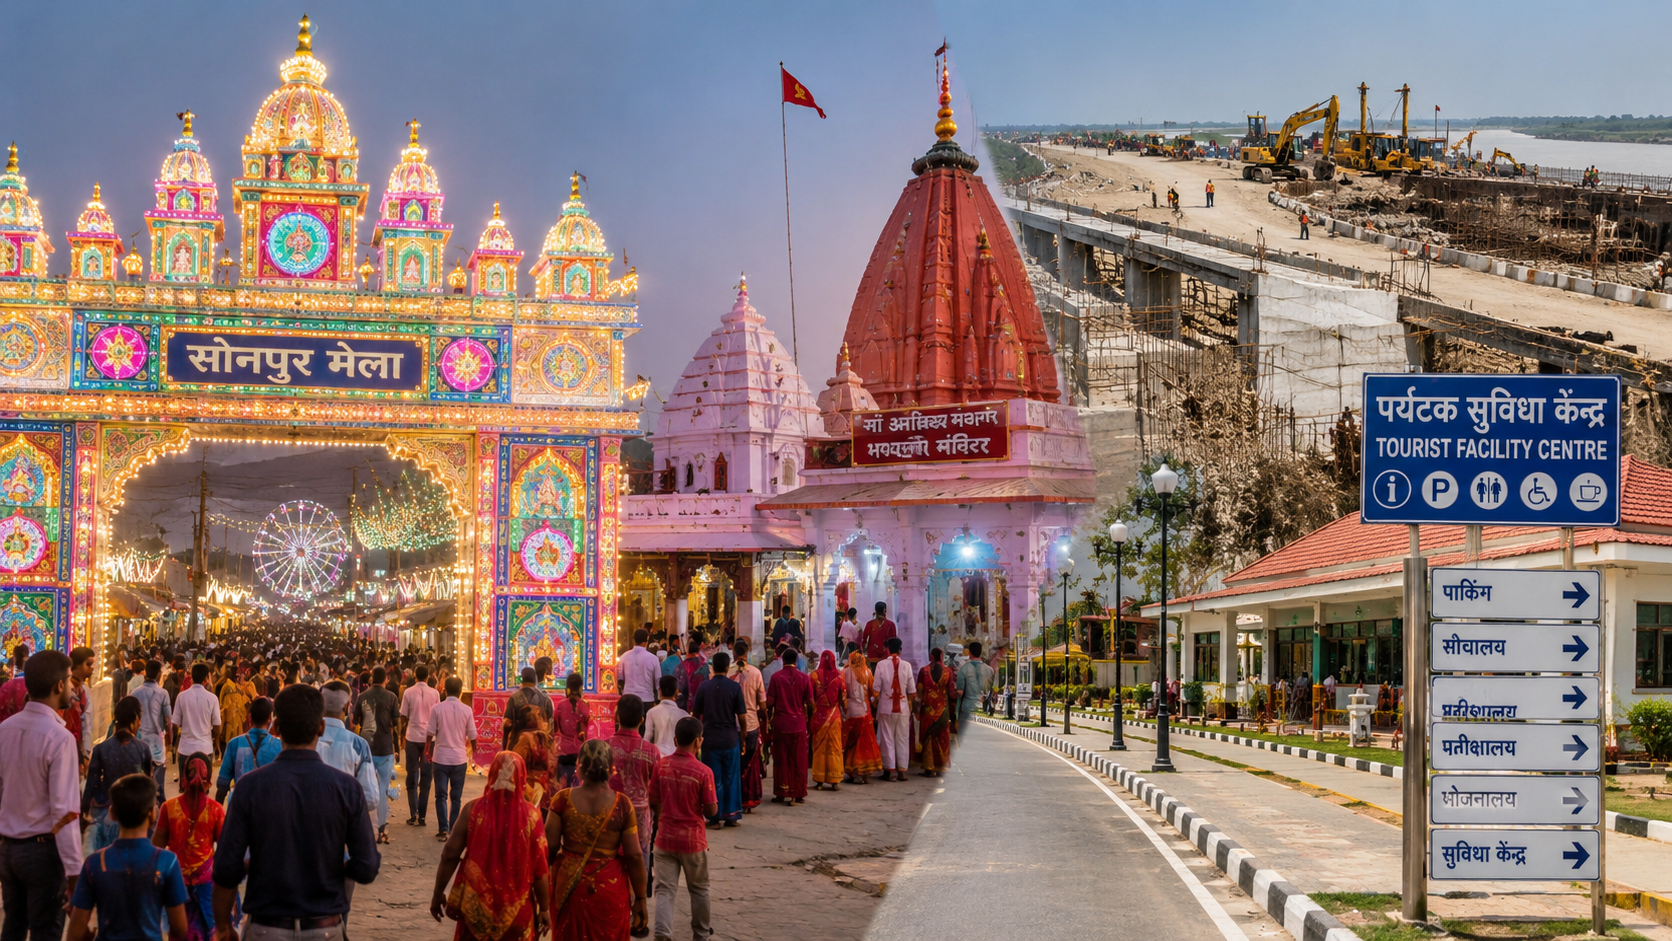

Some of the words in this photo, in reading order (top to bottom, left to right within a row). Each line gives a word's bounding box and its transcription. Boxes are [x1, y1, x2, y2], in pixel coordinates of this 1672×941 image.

[186, 336, 314, 384] सोनपुर
[326, 341, 404, 379] मेला
[1376, 386, 1459, 423] पर्यटक
[1466, 387, 1547, 434] सुविधा
[1376, 437, 1451, 458] TOURIST
[1457, 438, 1533, 459] FACILITY
[1538, 440, 1608, 460] CENTRE
